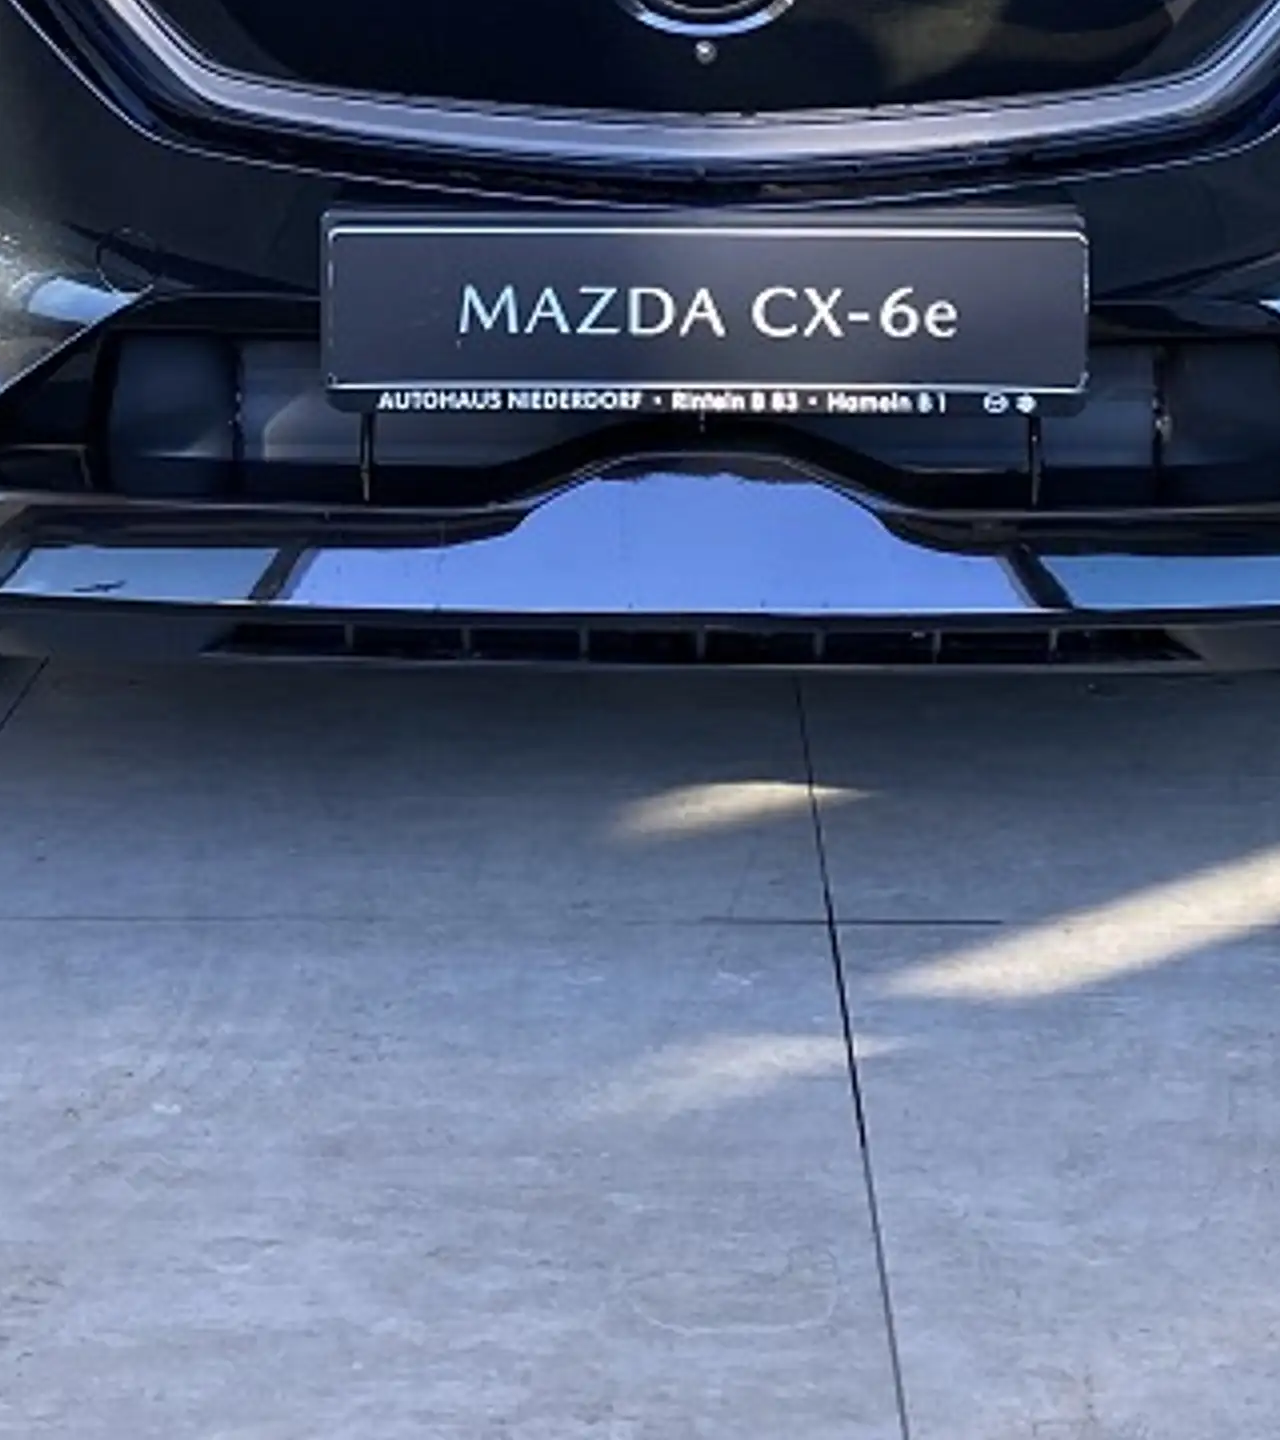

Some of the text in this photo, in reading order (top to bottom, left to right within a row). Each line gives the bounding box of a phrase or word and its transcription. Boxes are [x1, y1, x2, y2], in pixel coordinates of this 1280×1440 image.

[458, 285, 959, 338] MAZDA CX-6e
[377, 391, 502, 410] AUTOHAUS
[506, 391, 643, 410] NIEDERDORF
[826, 391, 913, 412] Hameln
